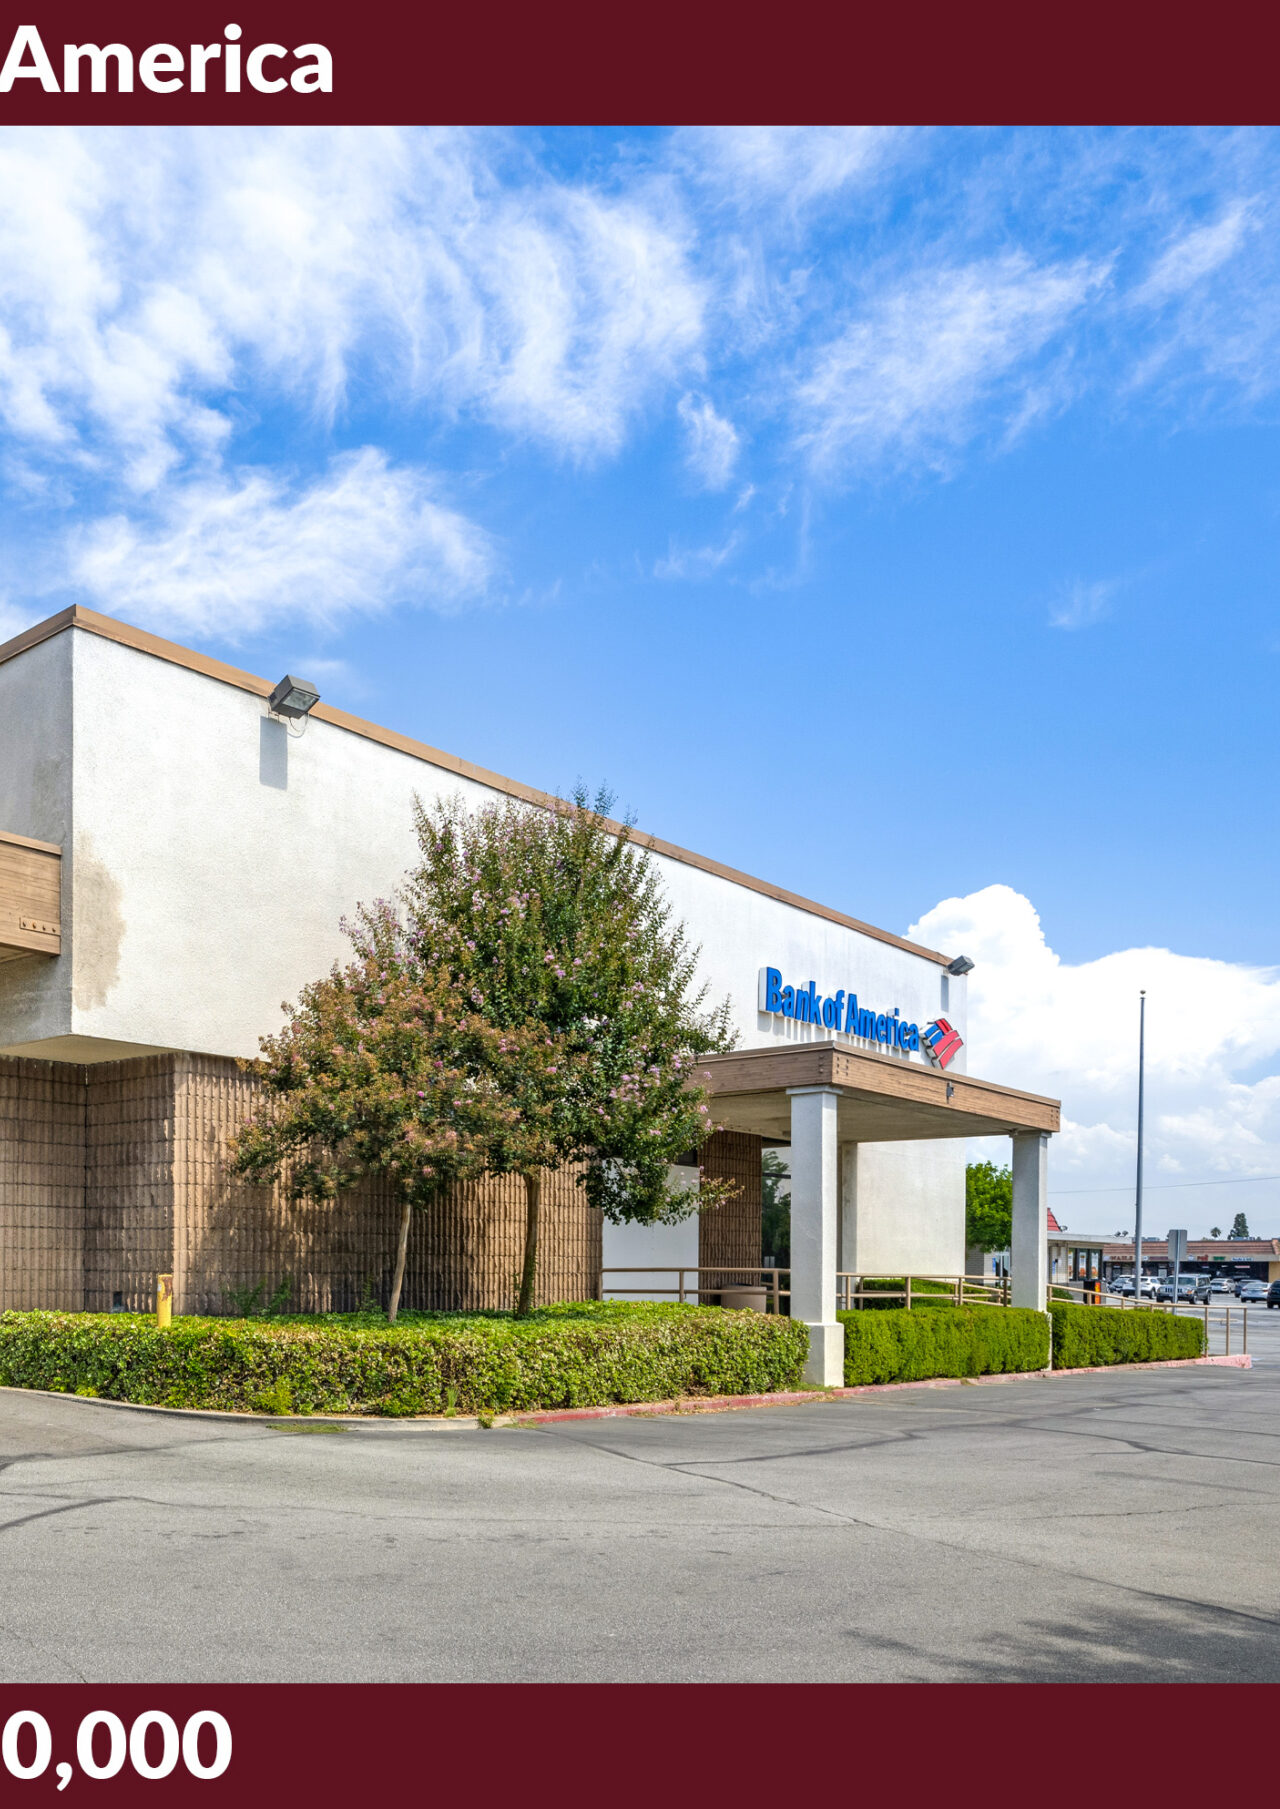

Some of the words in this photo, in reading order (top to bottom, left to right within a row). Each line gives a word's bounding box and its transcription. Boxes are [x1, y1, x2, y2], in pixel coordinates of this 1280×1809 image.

[760, 966, 822, 1026] Bank
[822, 989, 845, 1031] of
[845, 993, 920, 1051] America
